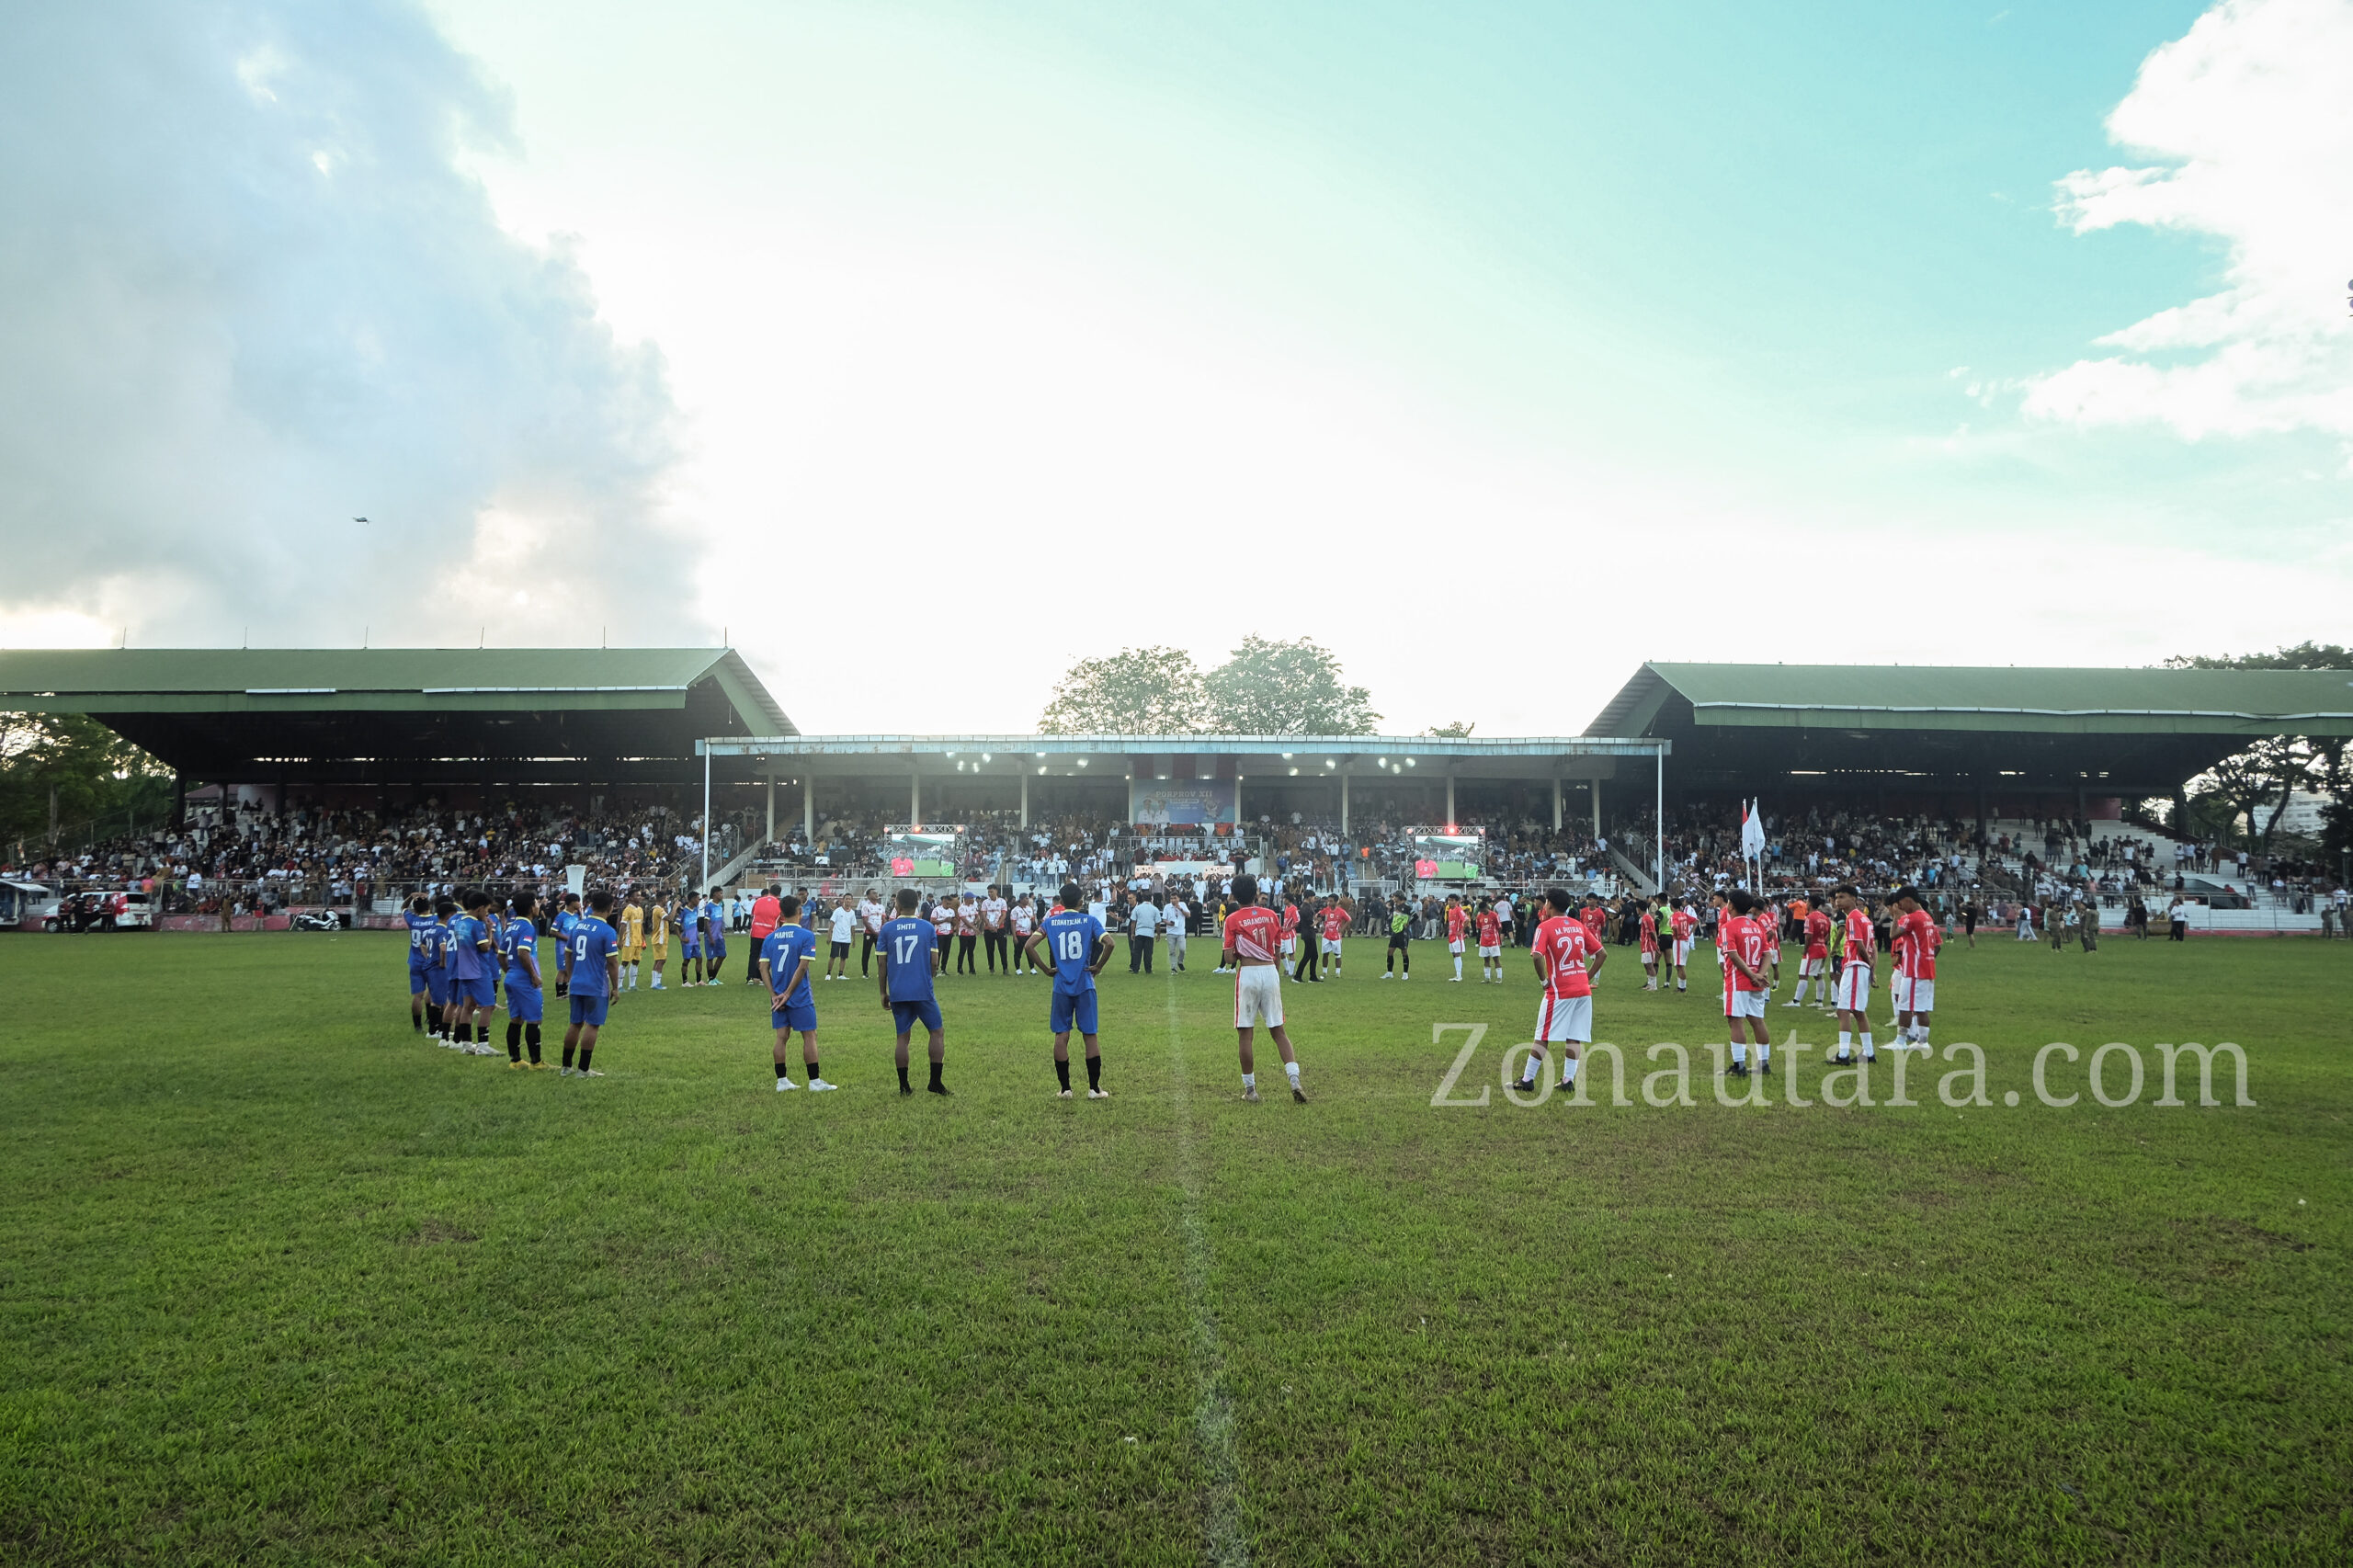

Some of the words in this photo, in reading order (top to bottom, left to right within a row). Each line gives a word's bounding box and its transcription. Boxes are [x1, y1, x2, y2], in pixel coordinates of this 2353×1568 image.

[896, 923, 916, 931] SMITH
[575, 935, 587, 961] 9
[778, 944, 790, 972] 7
[894, 935, 918, 965] 17
[1058, 930, 1083, 960] 18
[1557, 936, 1585, 971] 23
[1745, 936, 1762, 966] 12
